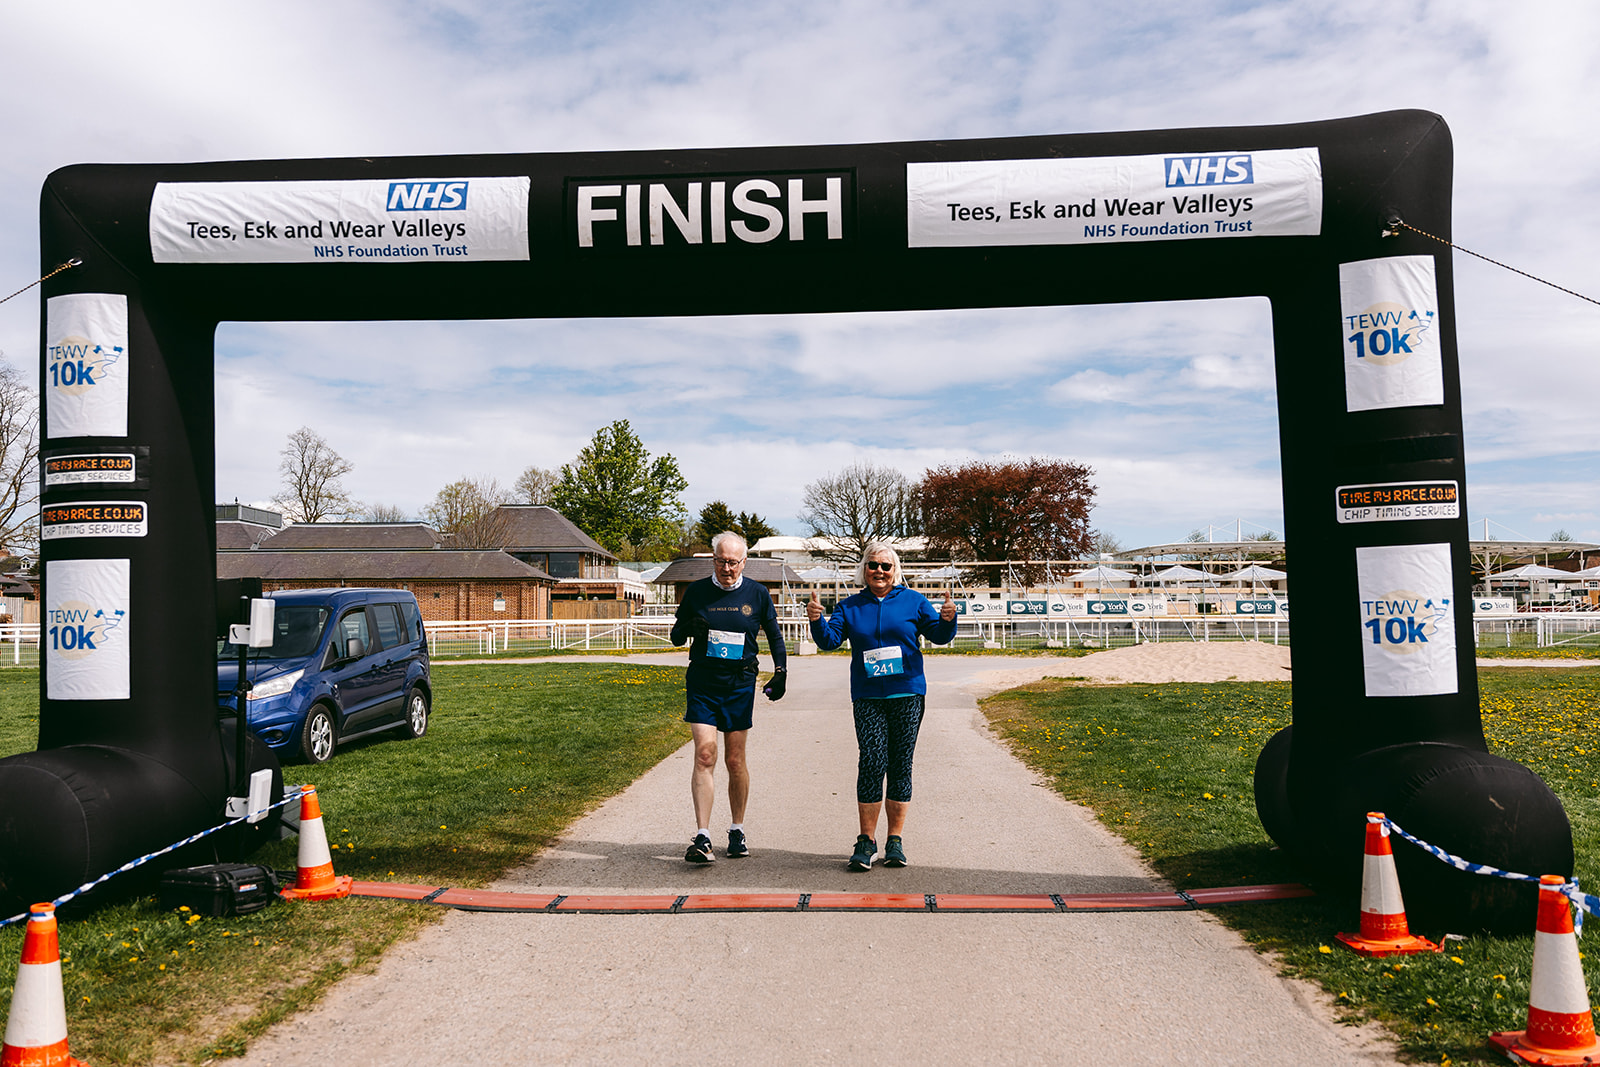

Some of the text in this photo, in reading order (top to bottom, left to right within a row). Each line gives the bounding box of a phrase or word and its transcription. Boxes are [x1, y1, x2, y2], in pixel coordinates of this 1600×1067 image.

[1167, 155, 1252, 186] NHS
[388, 182, 467, 210] NHS
[577, 177, 843, 248] FINISH
[947, 194, 1254, 222] Tees, Esk and Wear Valleys
[187, 218, 467, 241] Tees, Esk and Wear Valleys
[1084, 219, 1253, 238] NHS Foundation Trust
[314, 244, 468, 258] NHS Foundation Trust
[1346, 310, 1403, 330] TEWV
[1348, 327, 1413, 358] 10k
[49, 344, 88, 360] TEWV
[49, 360, 96, 387] 10k
[87, 472, 131, 481] SERVICES
[1344, 504, 1456, 520] CHIP TIMING SERVICES
[88, 523, 141, 534] SERVICES
[987, 603, 1003, 611] York
[1067, 603, 1084, 611] York
[1107, 603, 1124, 611] York
[1256, 602, 1272, 611] York
[1362, 599, 1419, 616] TEWV
[1495, 601, 1510, 609] York
[48, 609, 89, 624] TEWV
[49, 625, 97, 650] 10k
[1364, 616, 1429, 645] 10k
[720, 646, 728, 658] 3
[872, 662, 894, 676] 241
